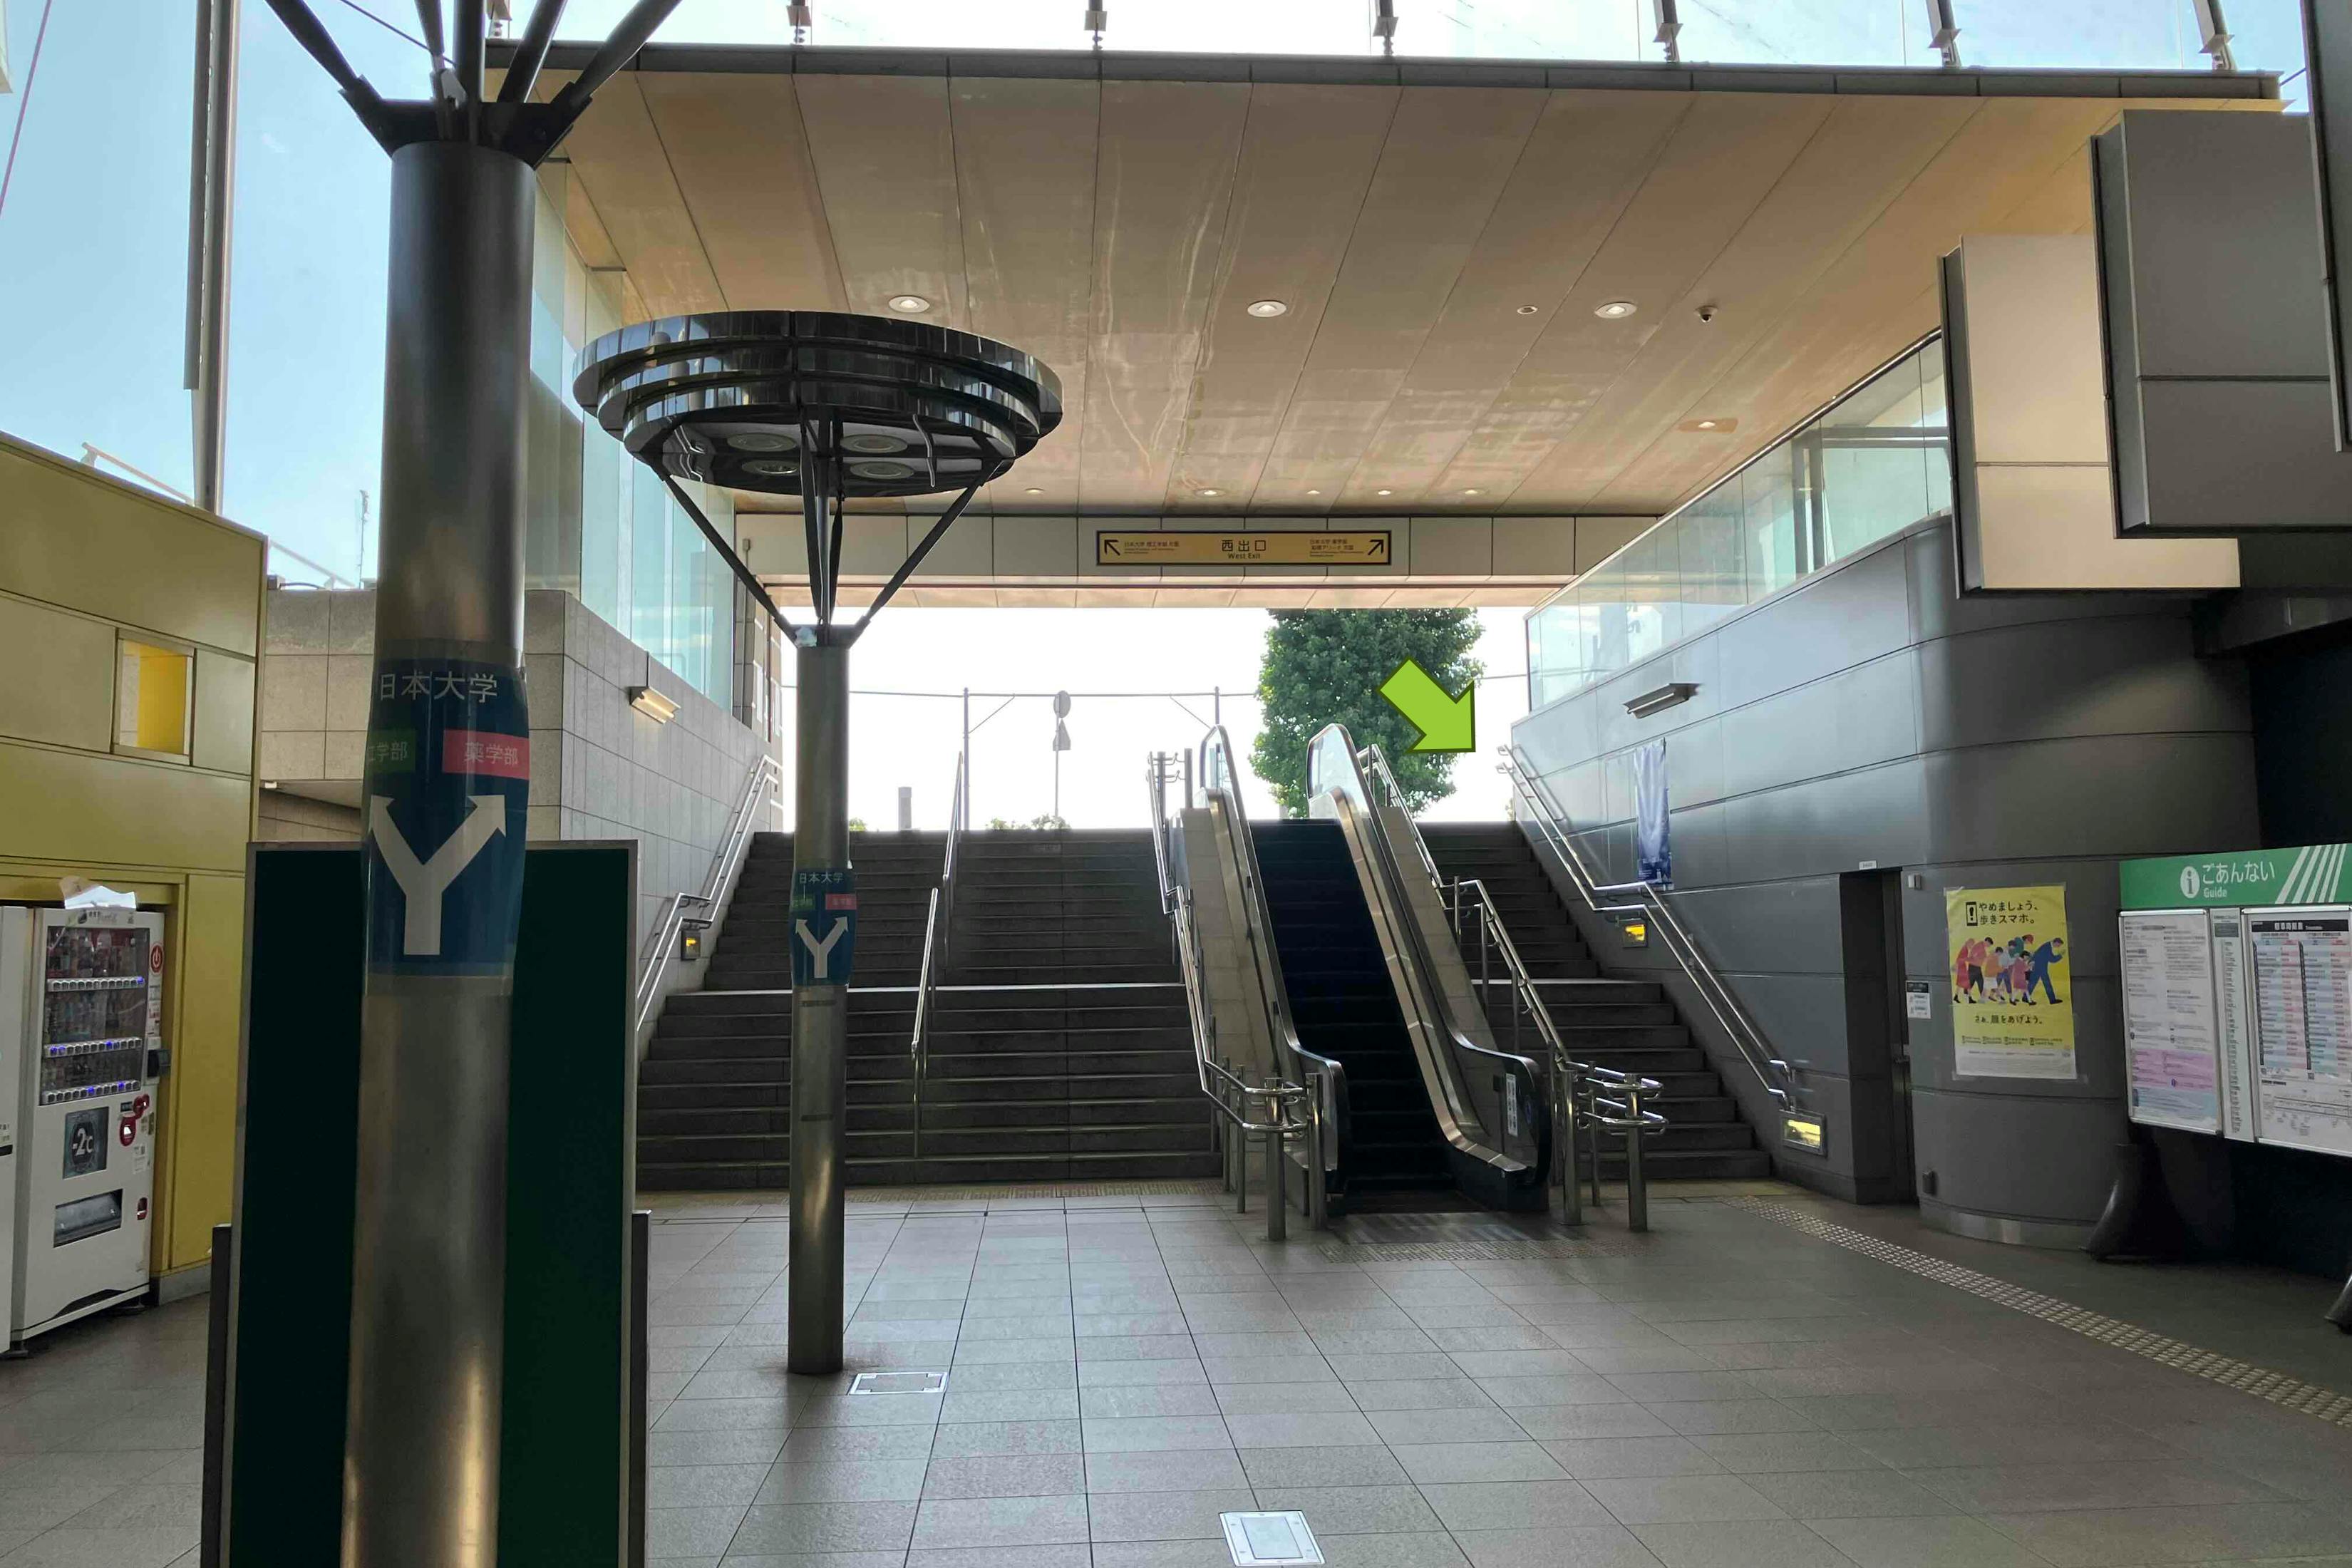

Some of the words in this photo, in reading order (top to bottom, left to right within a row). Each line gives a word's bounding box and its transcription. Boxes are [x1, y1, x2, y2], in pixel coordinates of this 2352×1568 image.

[1222, 540, 1266, 552] 西出口
[380, 669, 498, 703] 日本大学
[464, 741, 518, 765] 薬学部
[799, 872, 844, 884] 日本大学
[2202, 861, 2275, 884] ごあんない
[2204, 887, 2227, 898] Guide
